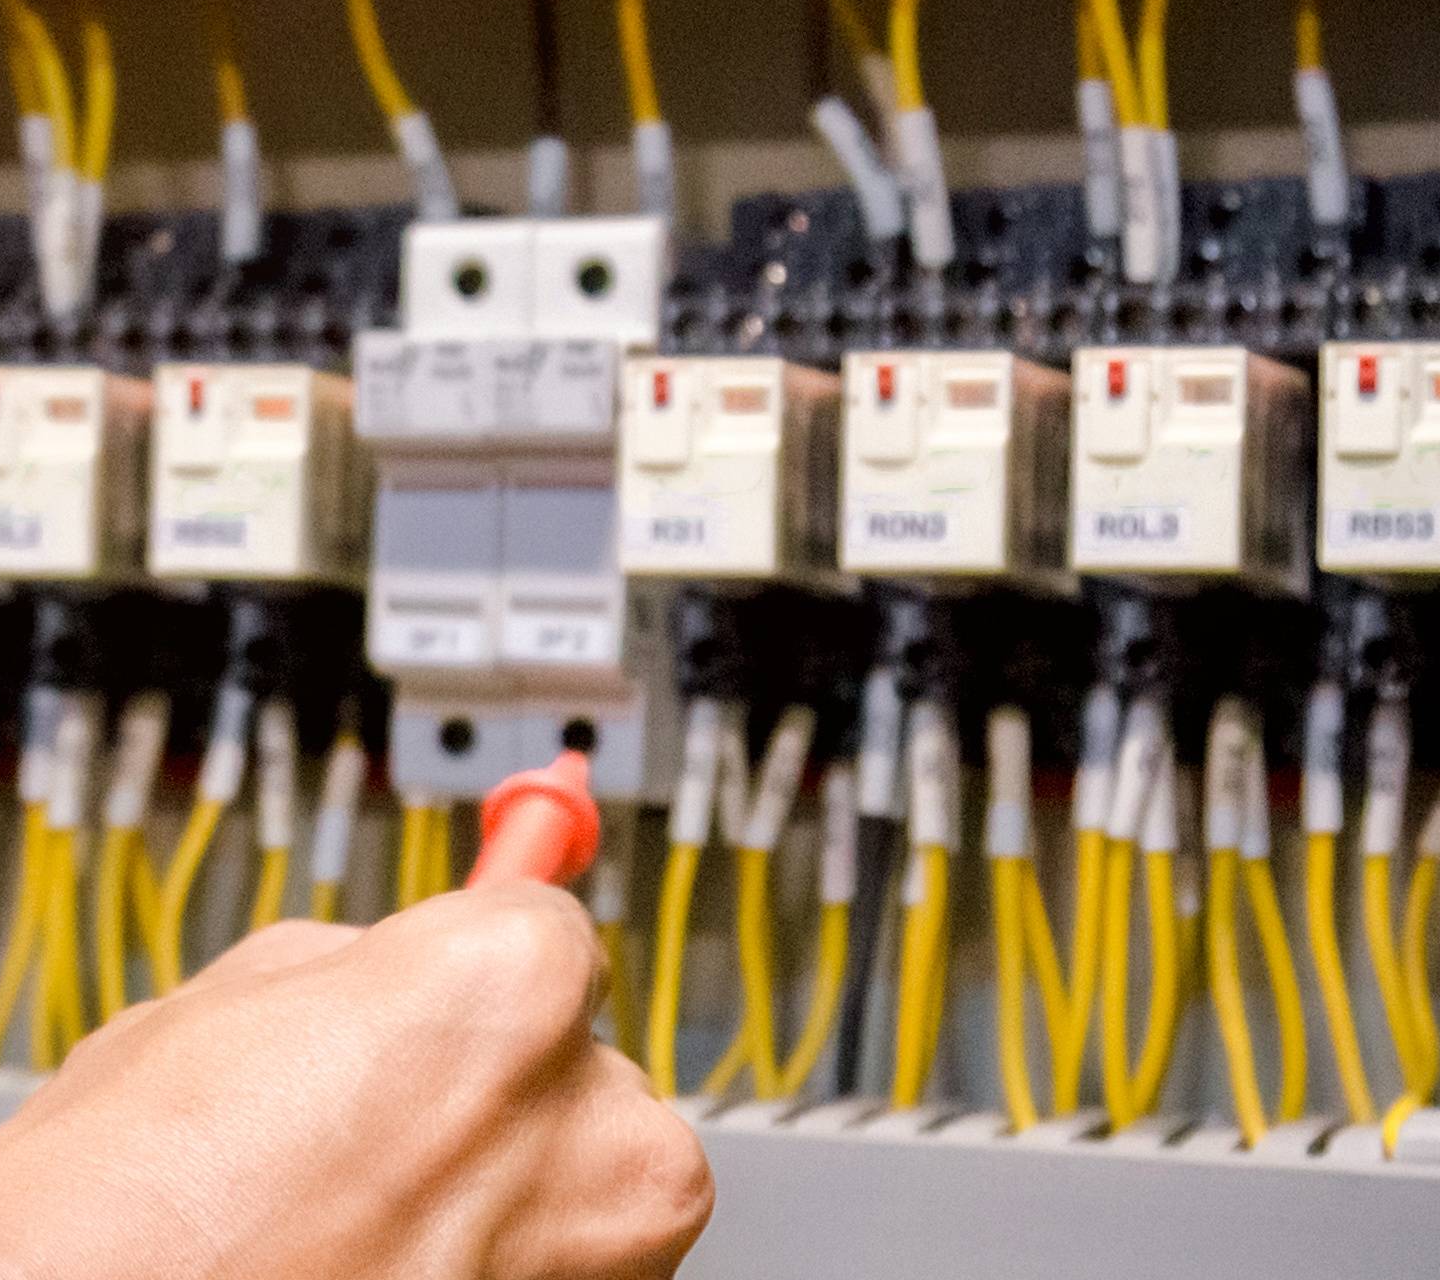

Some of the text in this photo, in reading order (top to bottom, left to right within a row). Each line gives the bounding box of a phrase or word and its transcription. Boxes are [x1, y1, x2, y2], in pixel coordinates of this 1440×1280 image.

[868, 510, 948, 541] RON3
[1096, 512, 1180, 541] ROL3
[1348, 512, 1437, 541] RBS3
